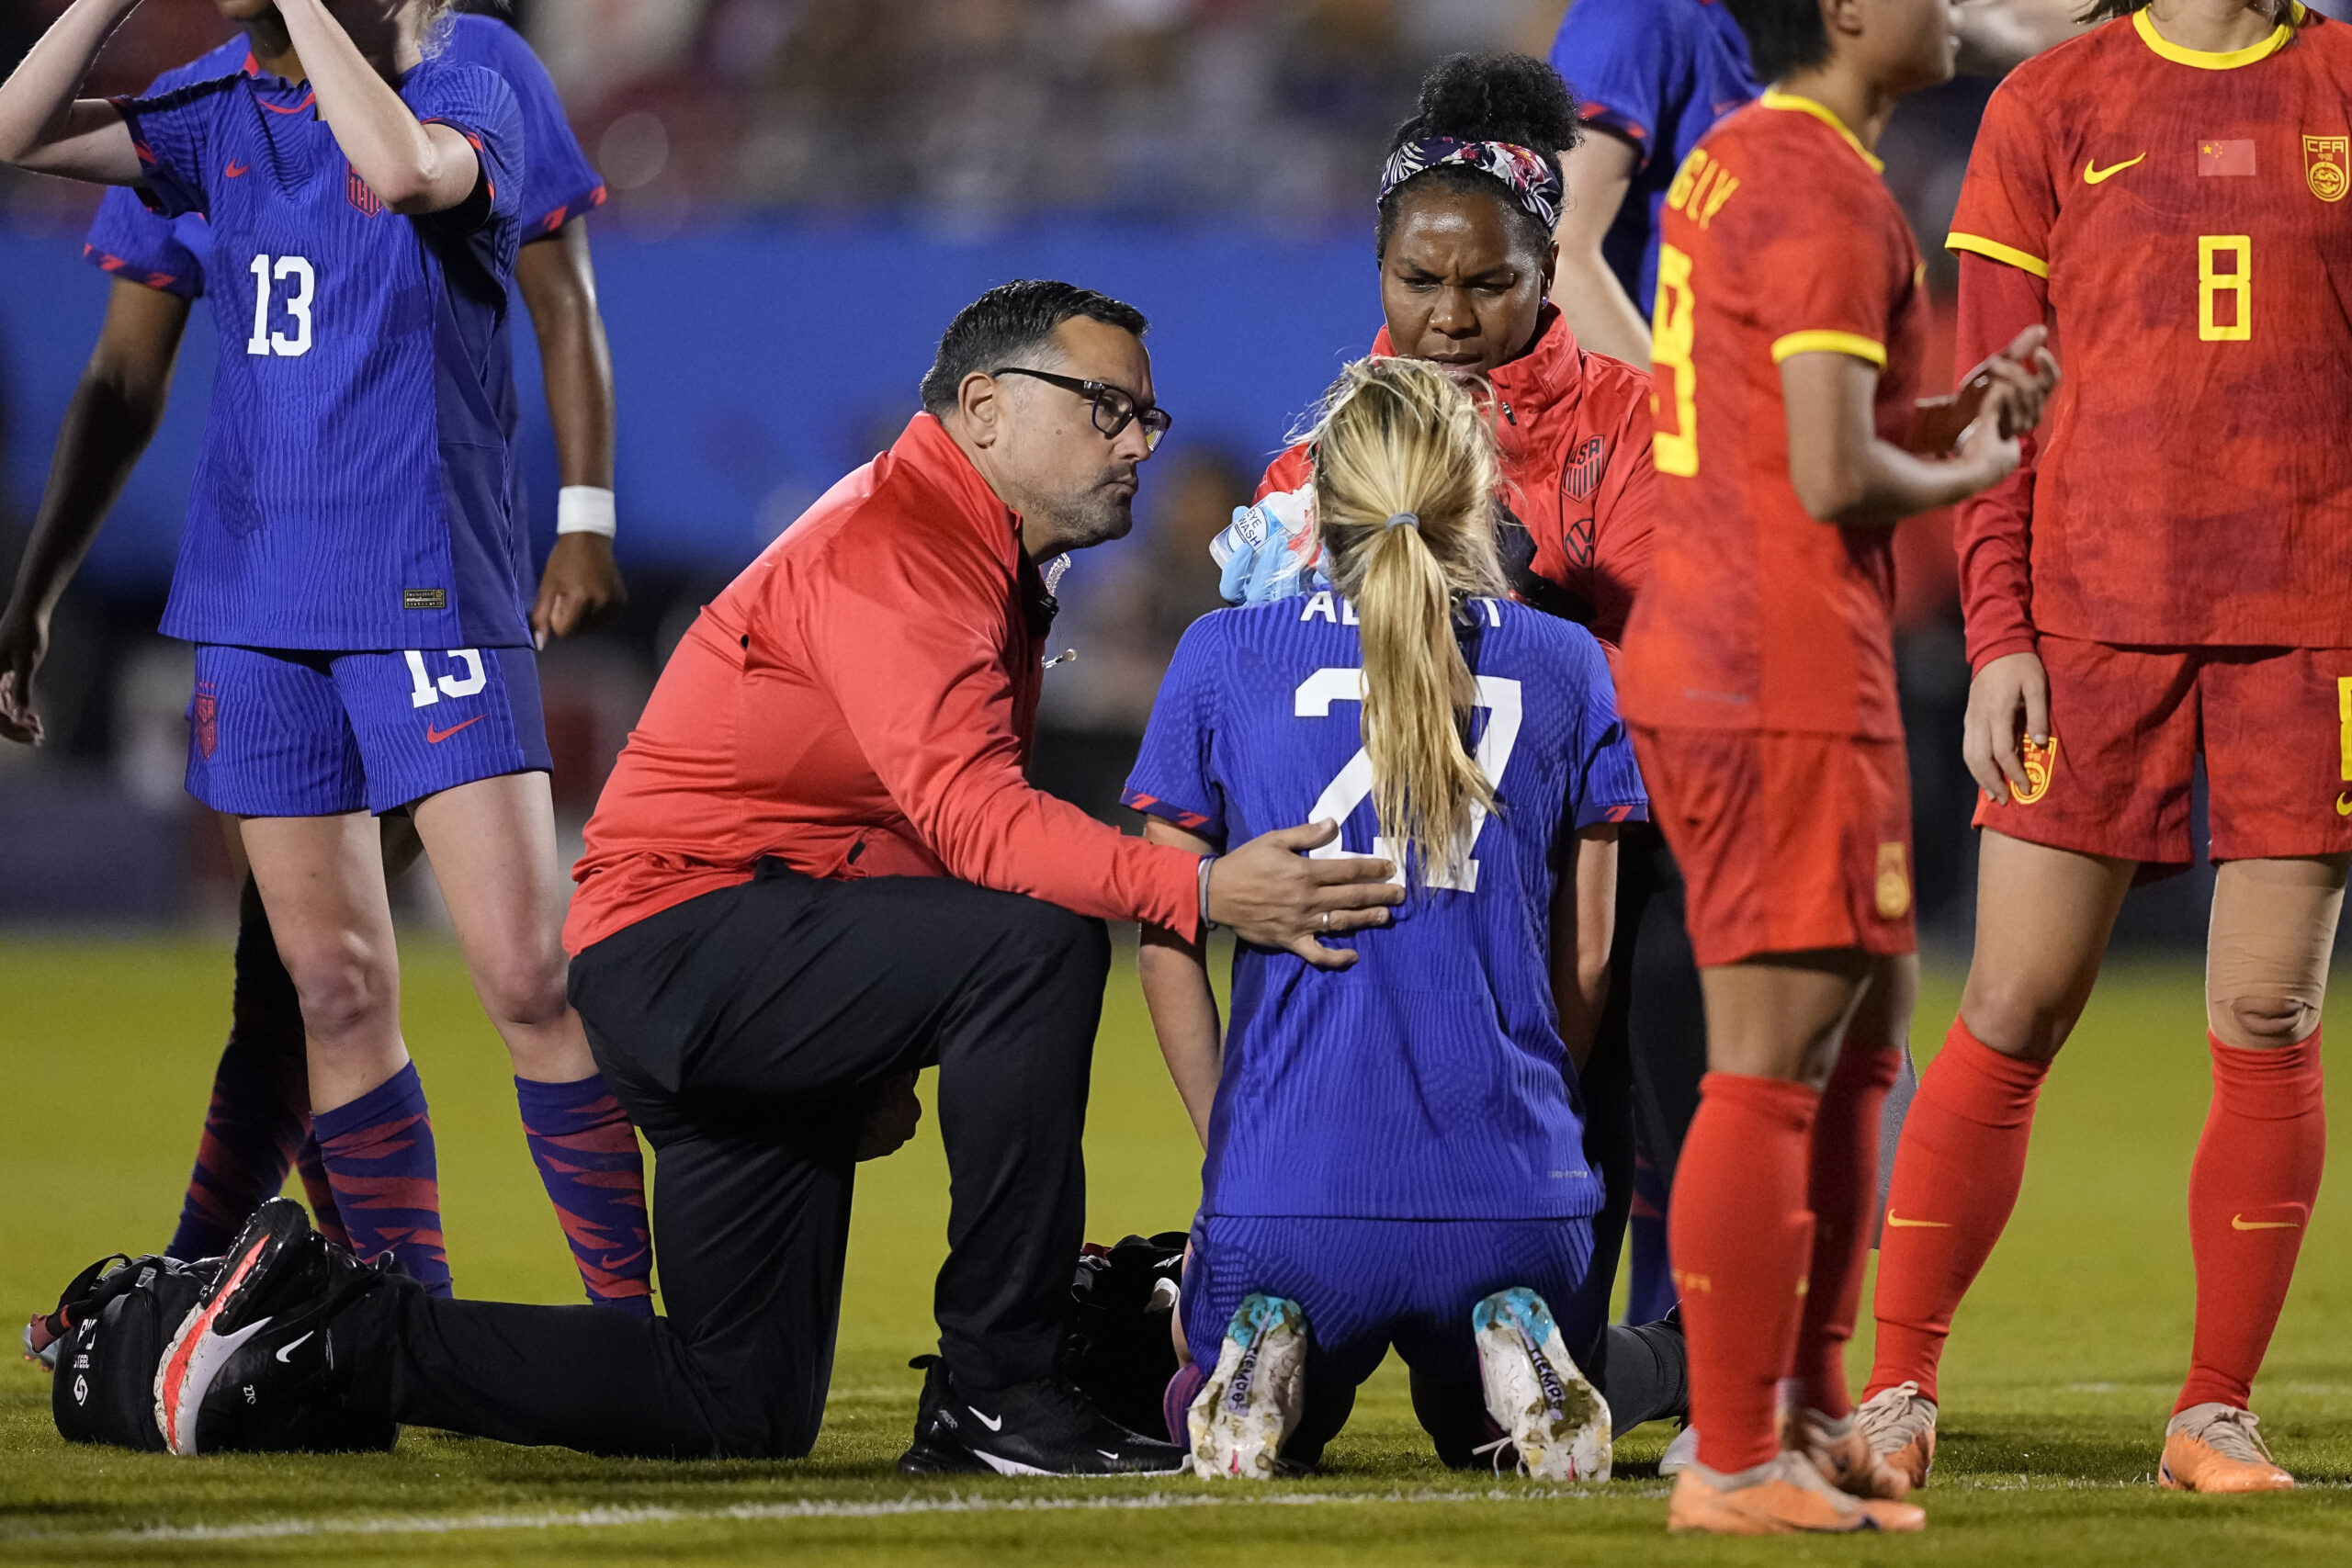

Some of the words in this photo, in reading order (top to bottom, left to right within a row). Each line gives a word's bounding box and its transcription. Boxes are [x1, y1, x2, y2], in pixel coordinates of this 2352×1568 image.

[2306, 140, 2345, 153] CFA
[247, 254, 315, 357] 13
[2198, 234, 2252, 342] 8
[1569, 442, 1600, 465] USA
[1238, 517, 1262, 547] WASH
[1247, 508, 1262, 529] EYE
[1300, 591, 1501, 627] ALRT
[403, 648, 488, 709] 13
[1294, 668, 1523, 894] 27
